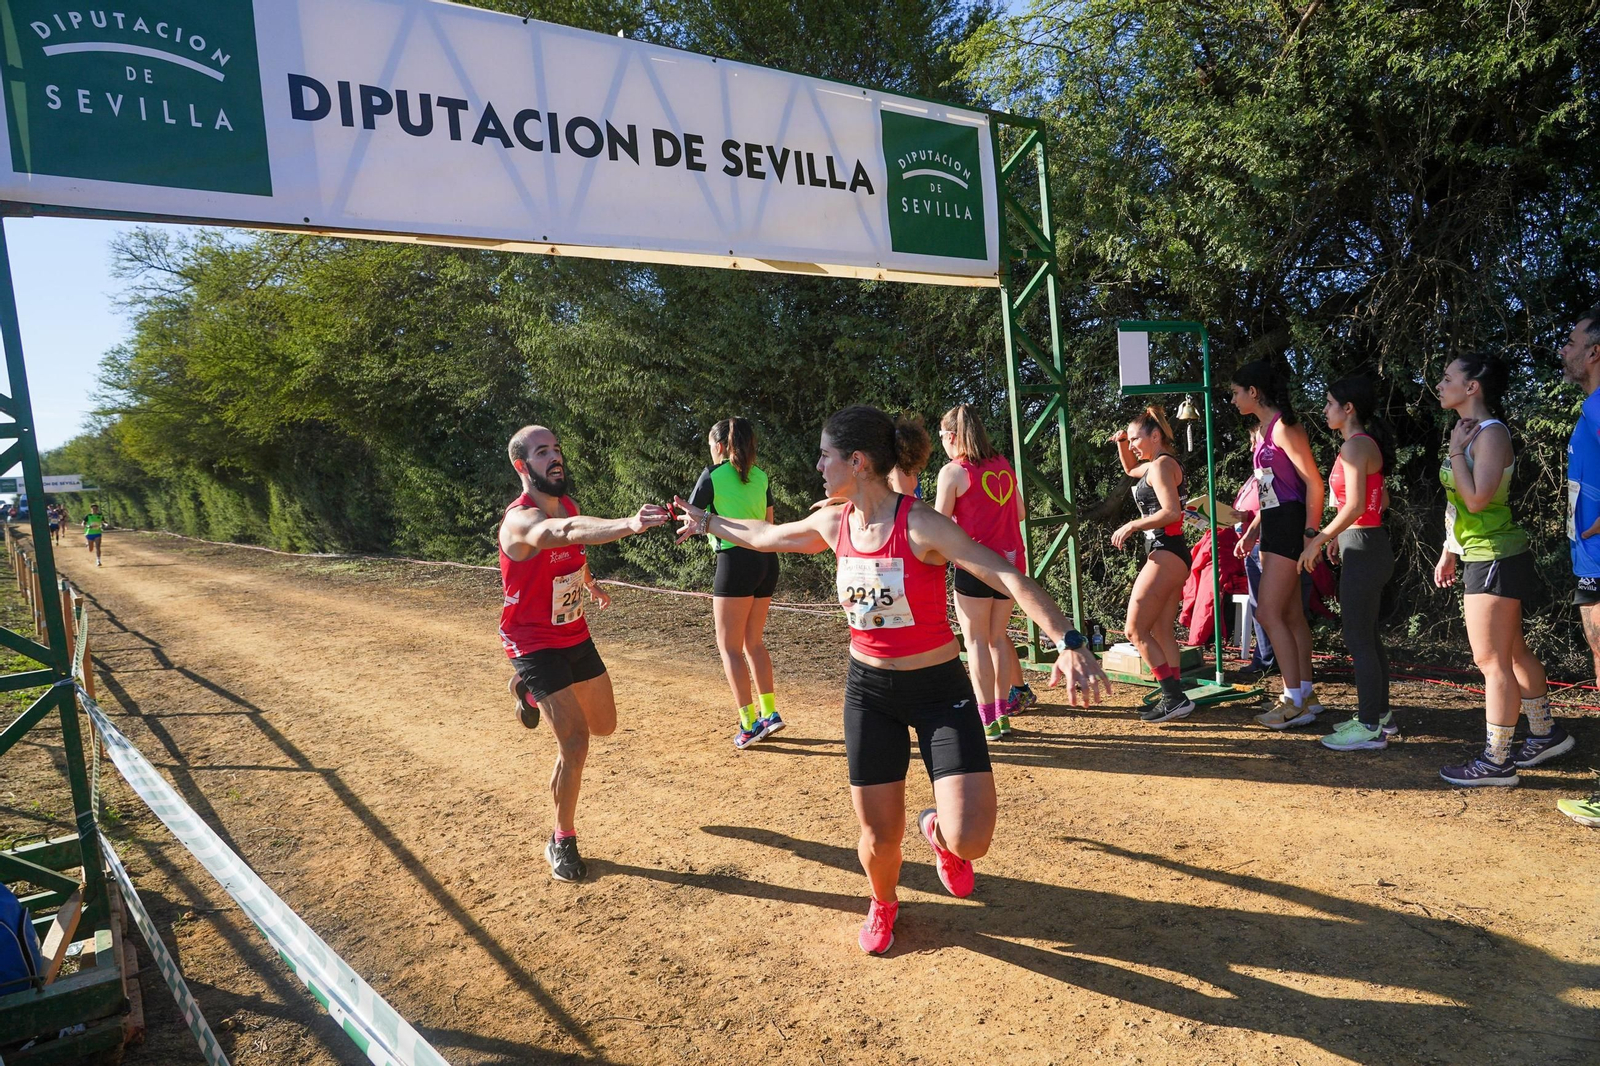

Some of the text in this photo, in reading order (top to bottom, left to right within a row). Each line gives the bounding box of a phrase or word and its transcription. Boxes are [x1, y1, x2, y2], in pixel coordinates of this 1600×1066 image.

[30, 10, 231, 67] DIPUTACION
[125, 65, 154, 84] DE
[45, 84, 234, 132] SEVILLA
[287, 73, 875, 195] DIPUTACION DE SEVILLA
[898, 149, 971, 180] DIPUTACION
[930, 182, 942, 193] DE
[901, 196, 973, 221] SEVILLA
[846, 586, 894, 607] 2215
